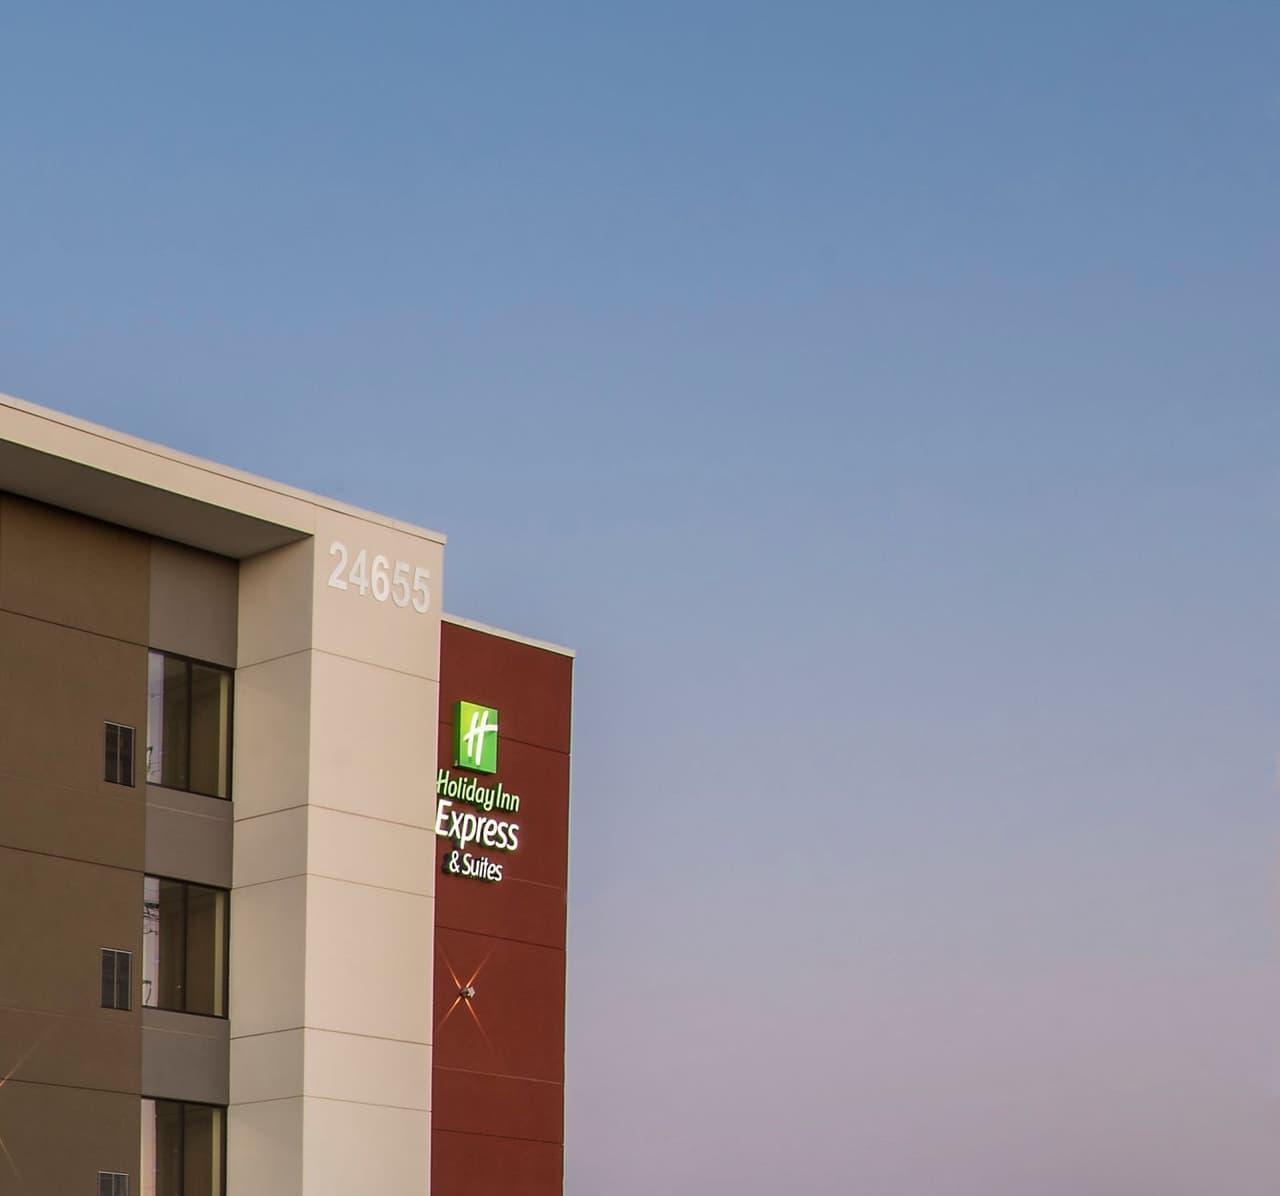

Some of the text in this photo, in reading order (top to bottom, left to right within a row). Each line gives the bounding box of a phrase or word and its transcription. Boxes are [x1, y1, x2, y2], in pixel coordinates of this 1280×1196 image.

[328, 541, 431, 615] 24655
[436, 768, 520, 812] Holiday Inn
[435, 799, 520, 851] Express
[449, 850, 503, 882] & Suites
